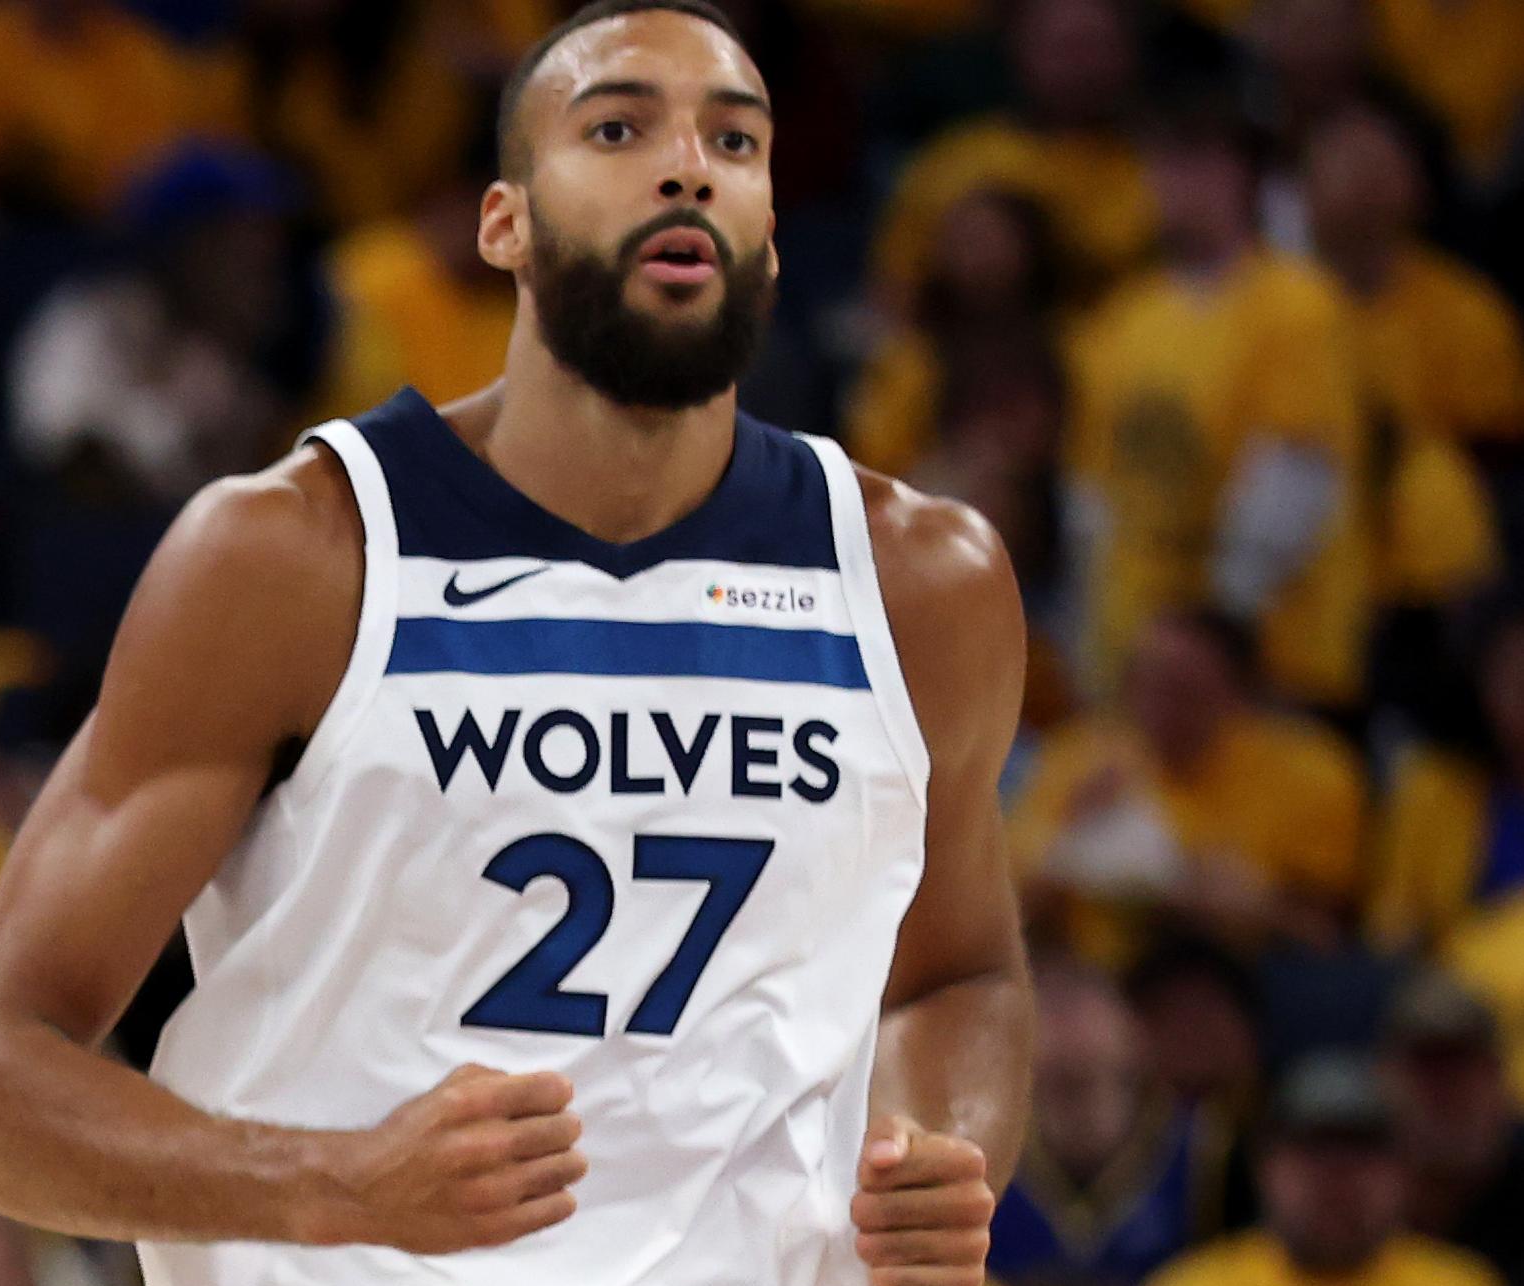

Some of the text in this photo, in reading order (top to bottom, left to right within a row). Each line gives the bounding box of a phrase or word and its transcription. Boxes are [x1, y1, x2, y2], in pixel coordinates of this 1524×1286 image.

[726, 585, 815, 612] sezzle
[412, 707, 841, 805] WOLVES
[458, 830, 777, 1040] 27
